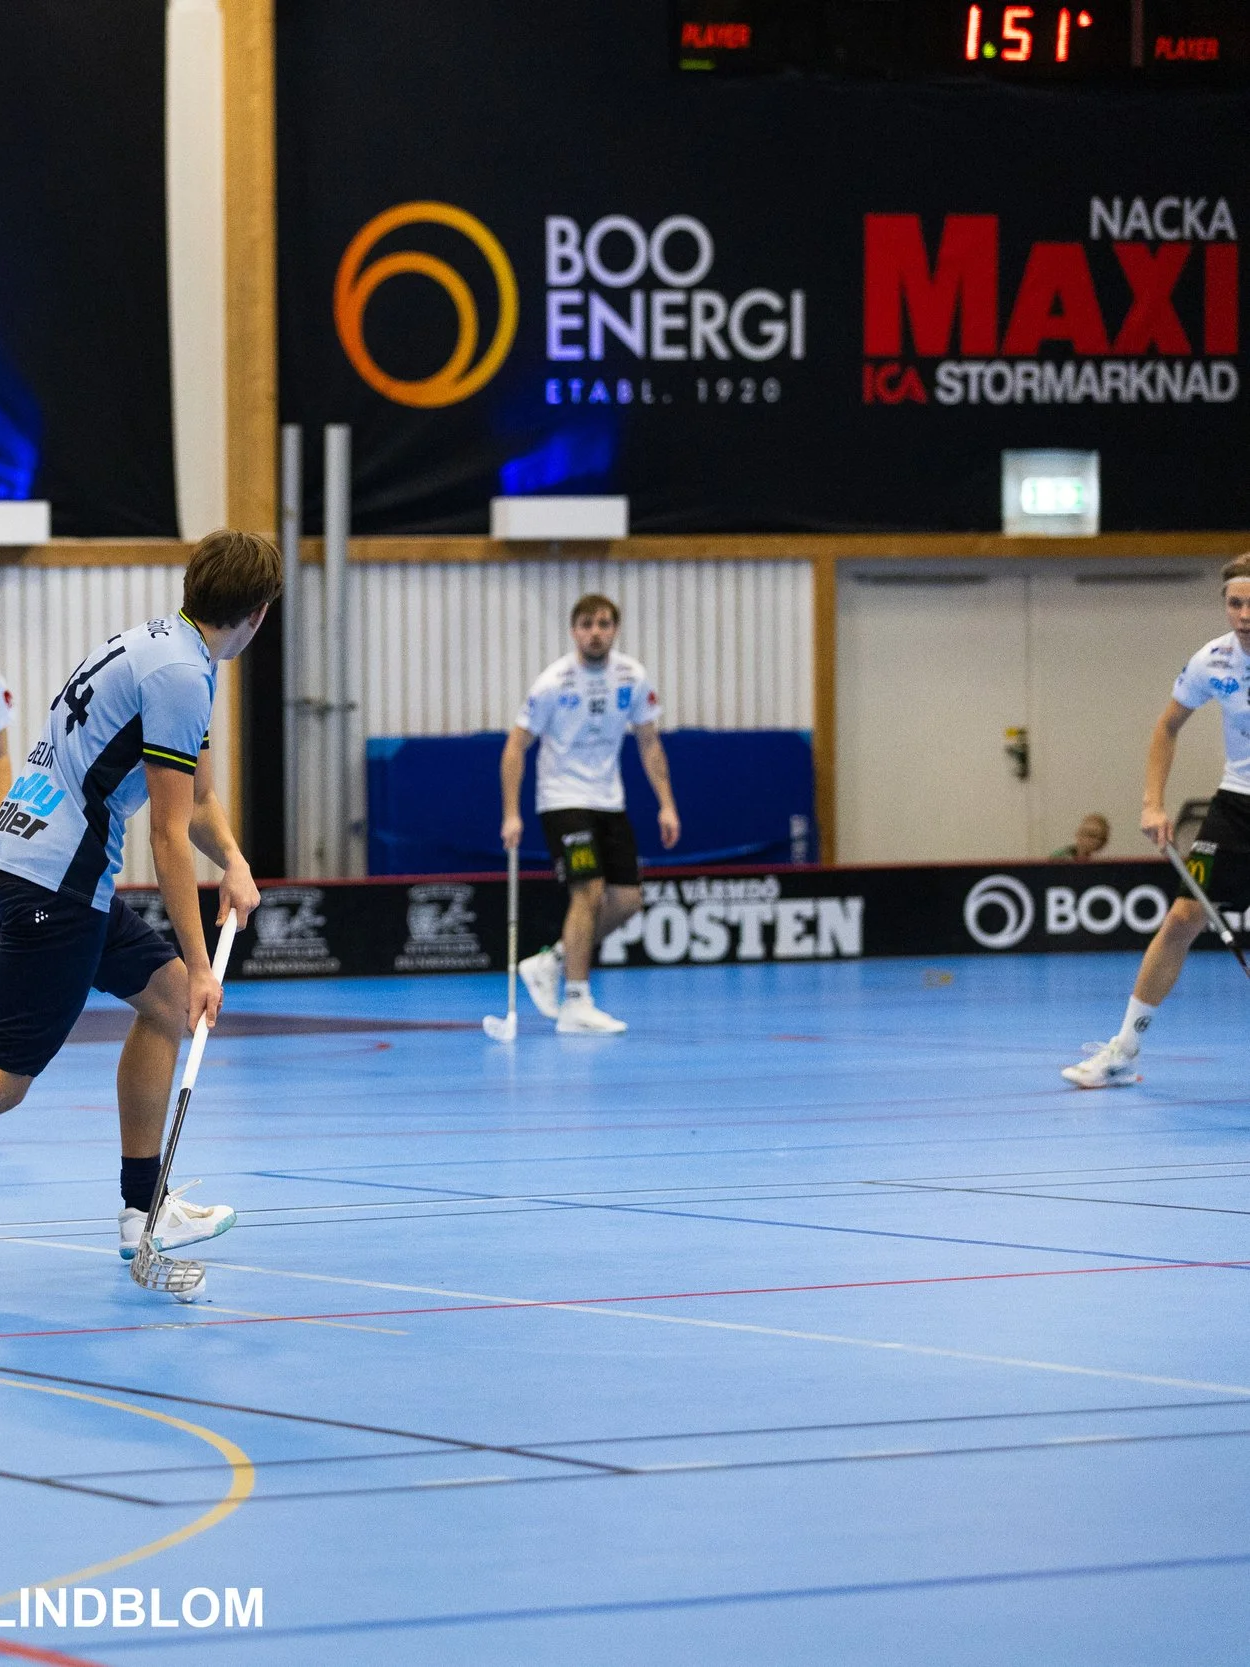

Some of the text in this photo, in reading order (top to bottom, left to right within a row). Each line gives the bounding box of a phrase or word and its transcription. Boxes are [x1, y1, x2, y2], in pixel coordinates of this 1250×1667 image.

[681, 22, 750, 49] PLAYER
[1154, 37, 1220, 61] PLAYER
[1089, 196, 1238, 241] NACKA
[545, 213, 715, 289] BOO
[545, 287, 806, 362] ENERGI
[697, 376, 782, 403] 1920
[862, 360, 1240, 405] ICA STORMARKNAD
[1045, 884, 1170, 935] BOO
